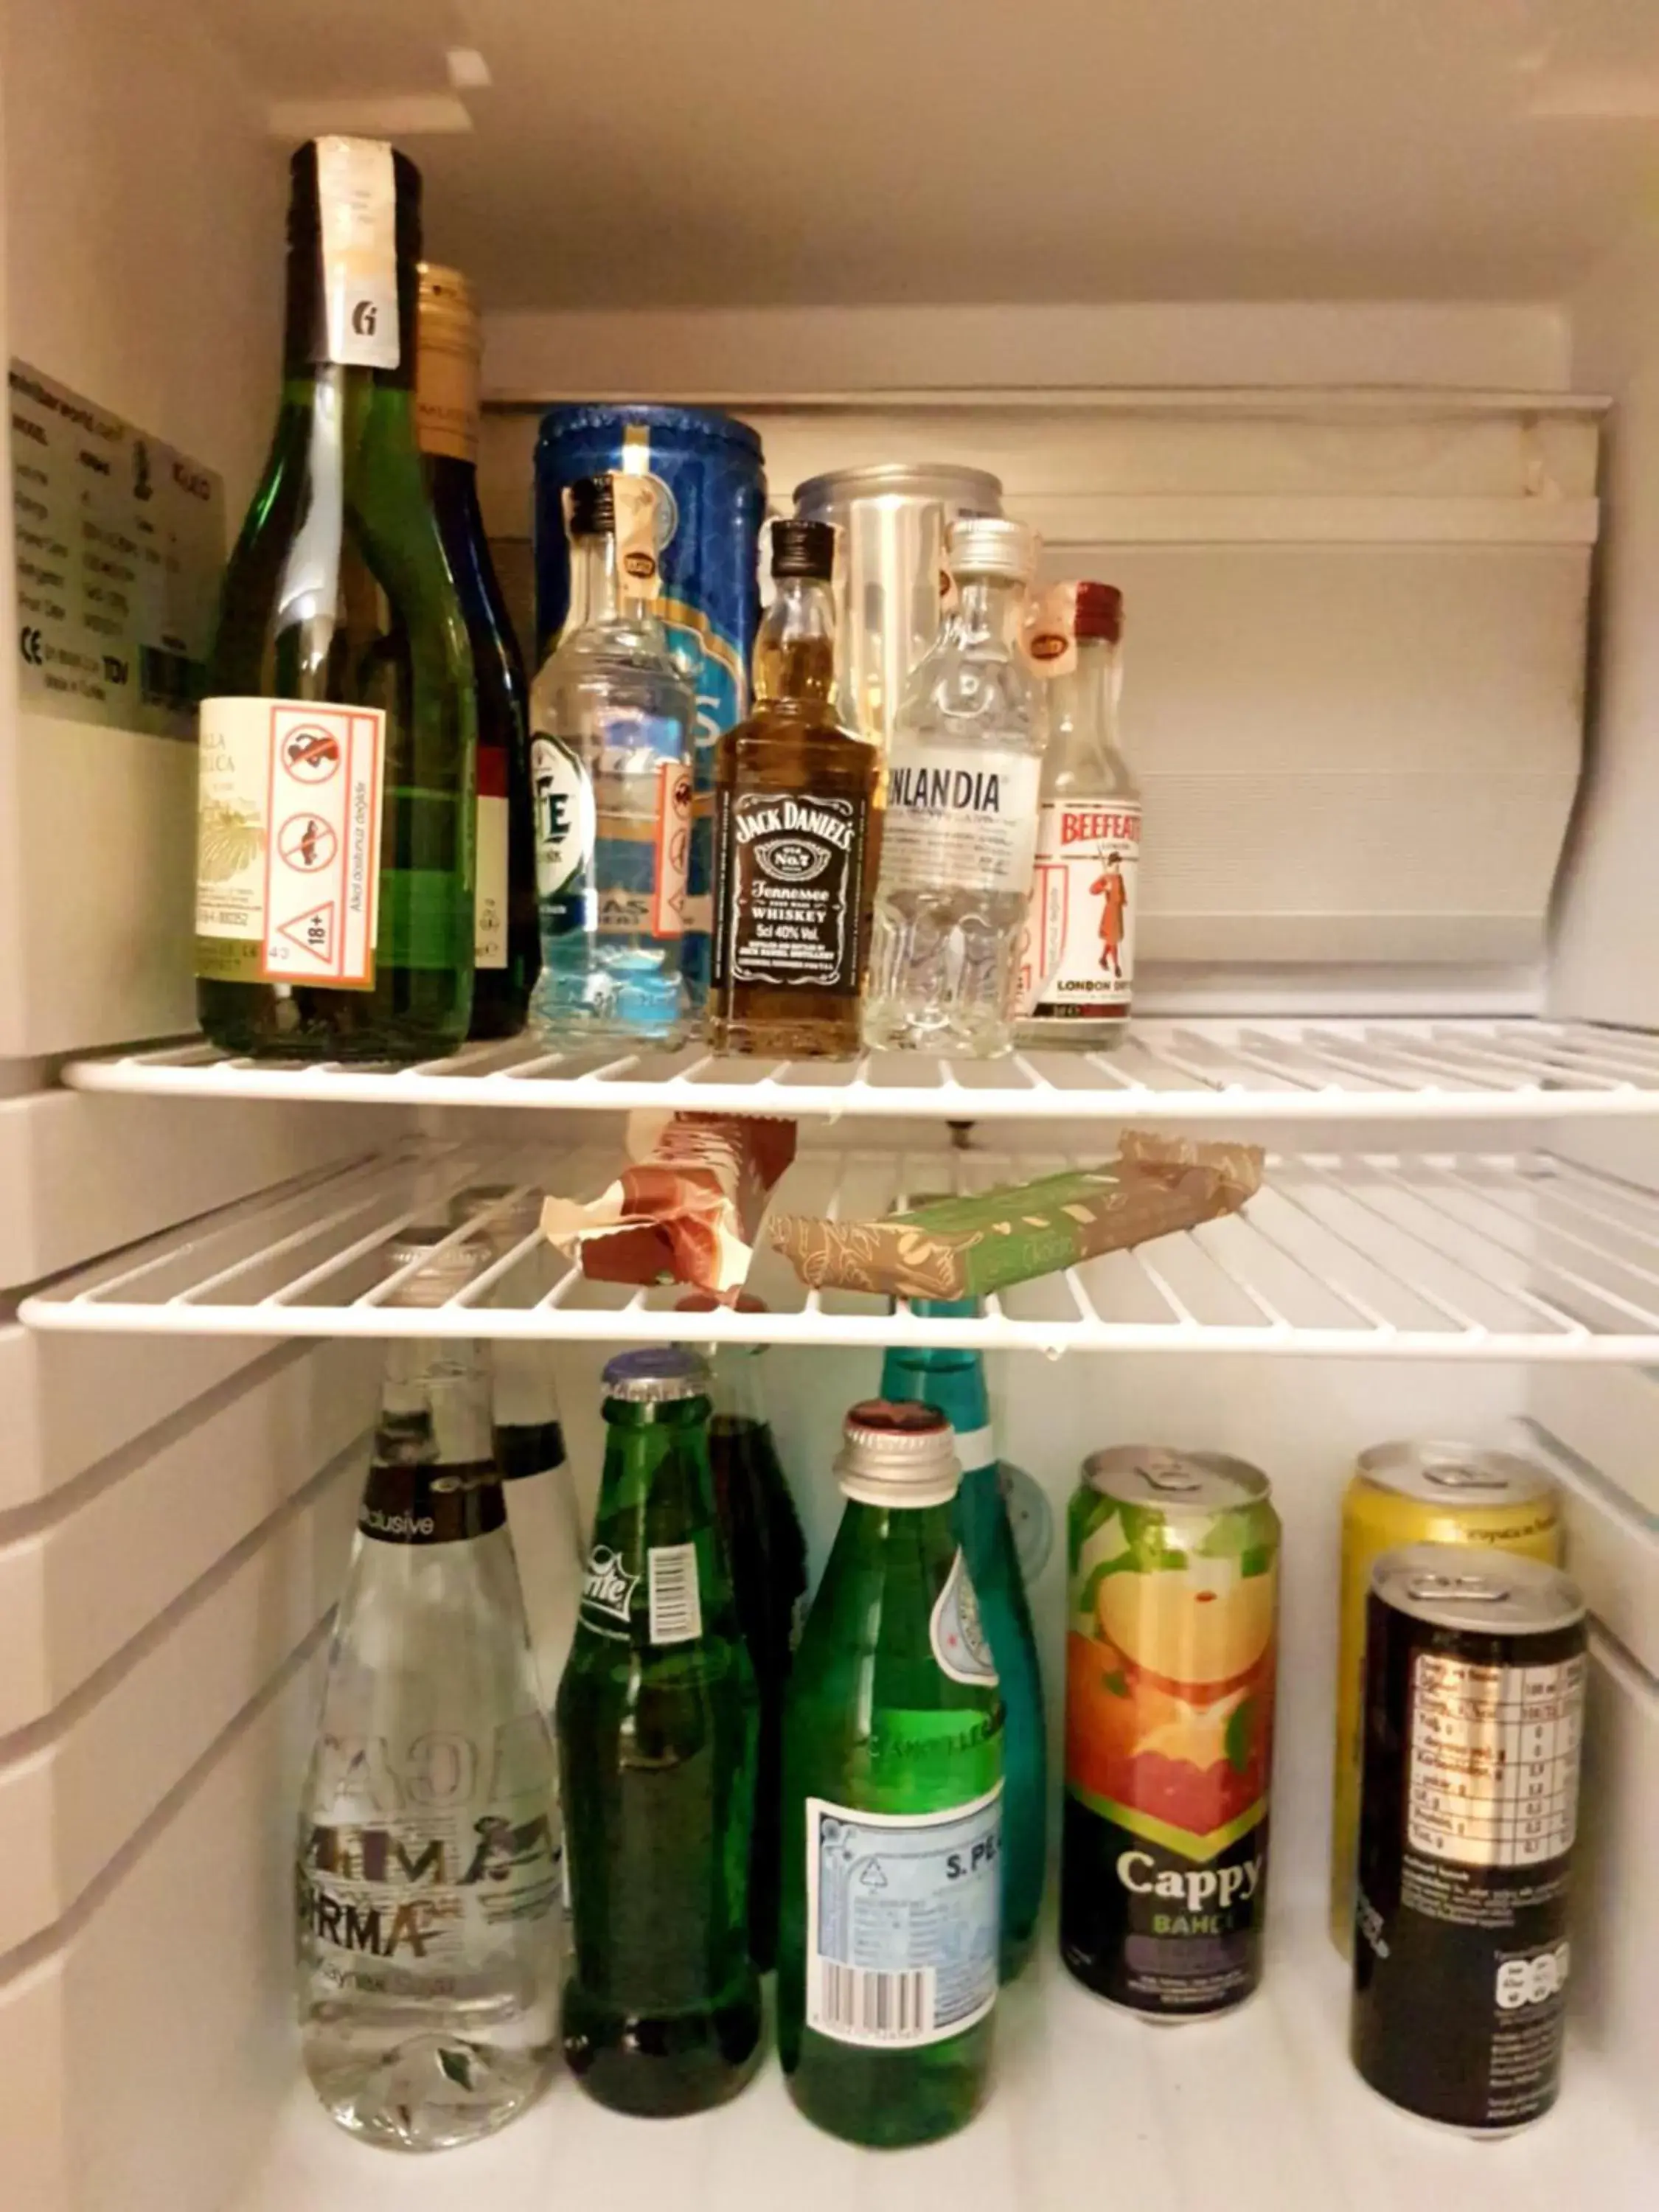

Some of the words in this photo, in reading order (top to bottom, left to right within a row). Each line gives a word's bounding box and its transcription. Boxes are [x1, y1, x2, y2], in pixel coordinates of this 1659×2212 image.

[889, 768, 1001, 813] NLANDIA
[736, 808, 782, 844] JACK
[784, 801, 855, 849] DANIEL'S
[307, 914, 326, 945] 18+
[752, 908, 827, 923] WHISKEY
[1057, 981, 1110, 991] LONDON
[1116, 1851, 1262, 1912] Cappy
